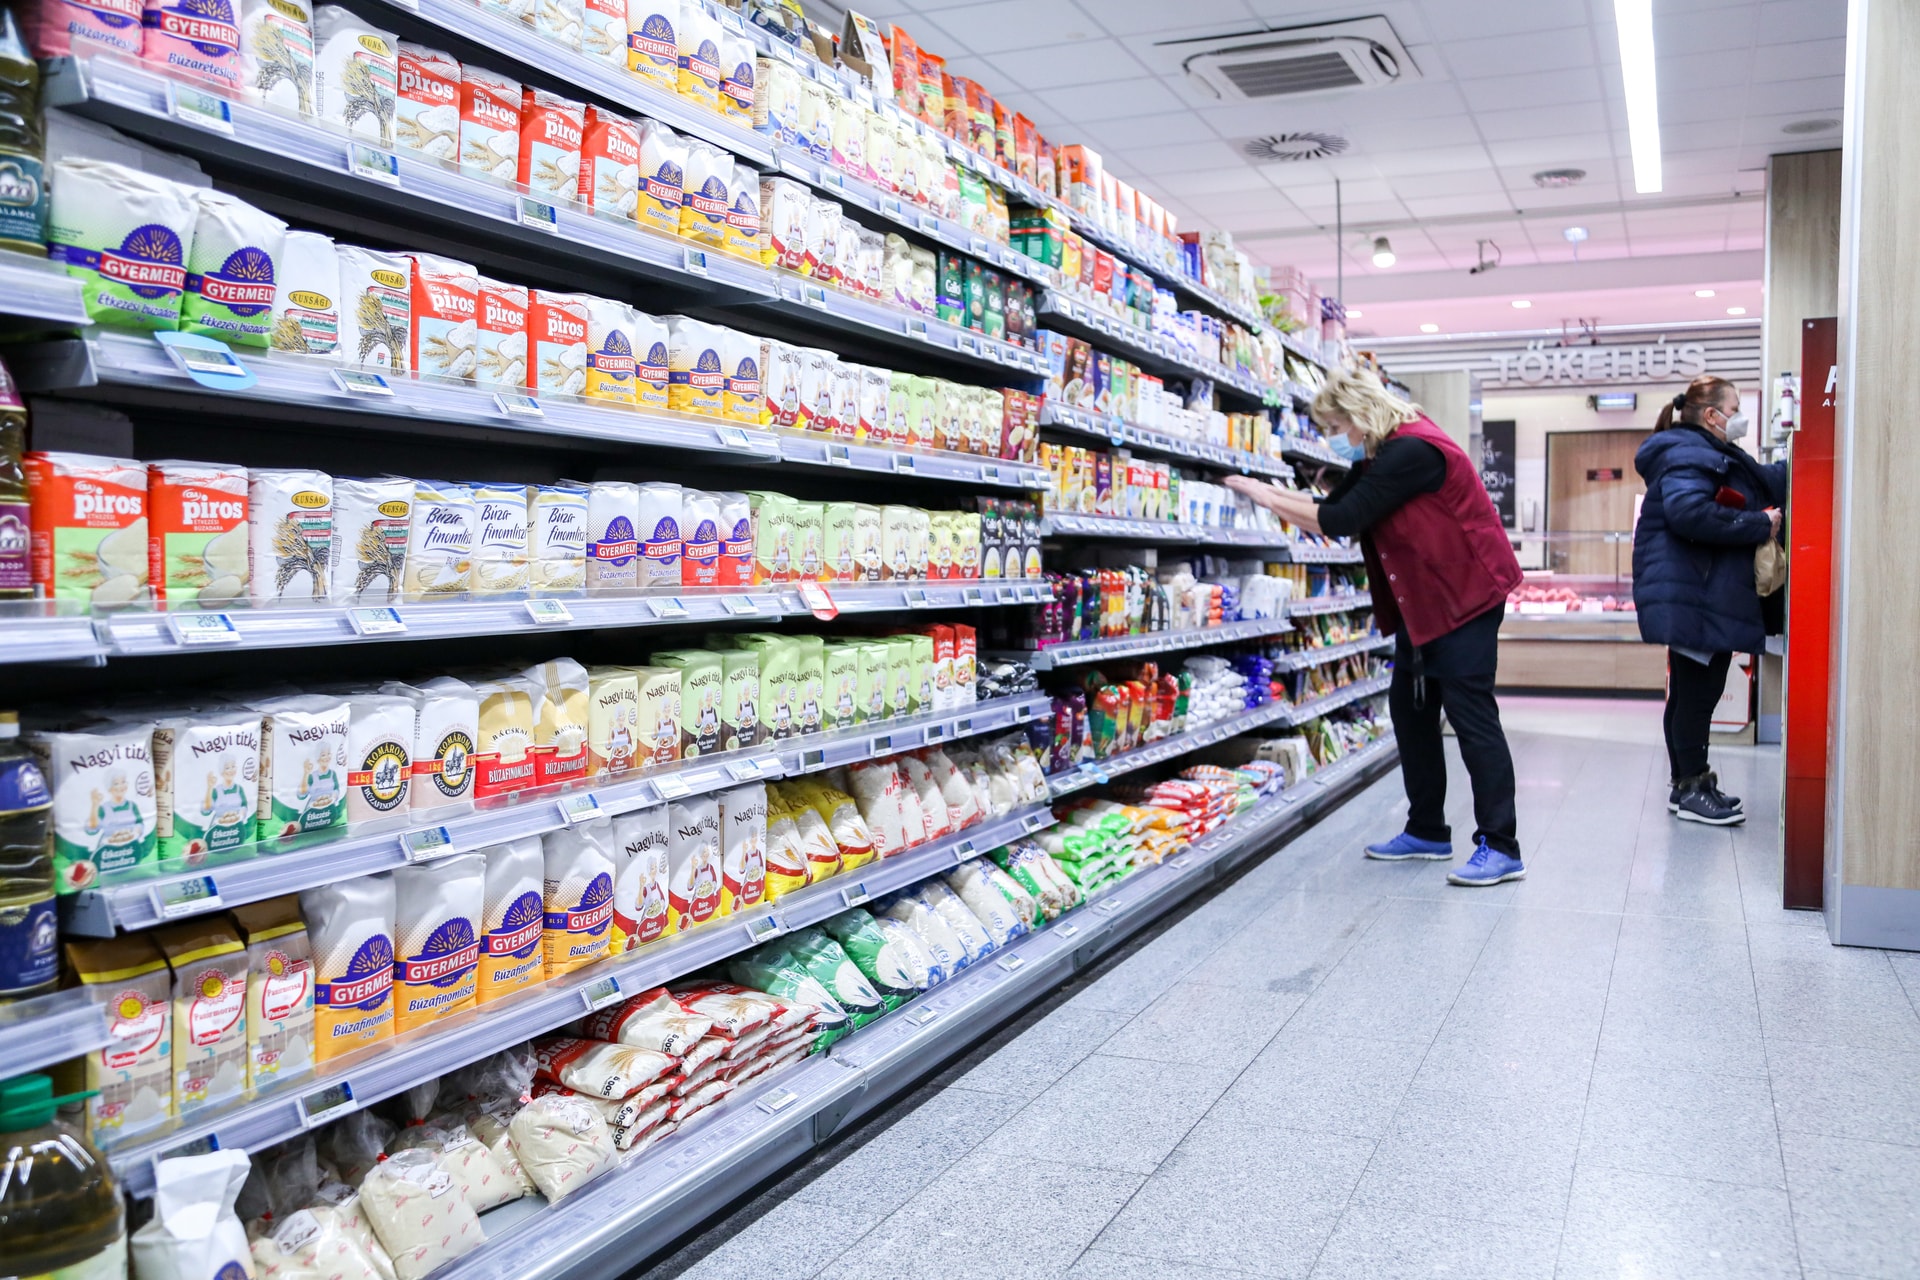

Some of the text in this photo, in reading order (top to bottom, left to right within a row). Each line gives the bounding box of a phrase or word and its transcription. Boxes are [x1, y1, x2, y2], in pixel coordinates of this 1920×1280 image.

[400, 70, 454, 100] piros
[473, 96, 517, 126] piros
[545, 119, 582, 146] piros
[607, 133, 638, 159] piros
[98, 291, 140, 314] Étkezési
[292, 293, 328, 308] KUNSÁGI
[431, 289, 475, 314] piros
[201, 315, 238, 331] Étkezési
[485, 302, 525, 326] piros
[547, 314, 584, 339] piros
[1490, 334, 1708, 386] TŐKEHÚS
[74, 487, 142, 520] piros
[182, 494, 243, 525] piros
[646, 682, 670, 701] Nagyi
[690, 672, 710, 690] Nagyi
[599, 689, 624, 709] Nagyi
[191, 730, 258, 759] Nagyi titka
[289, 722, 331, 747] Nagyi
[438, 731, 471, 755] KOMÁROMI
[492, 727, 528, 741] BÁCSKAI
[70, 743, 120, 774] Nagyi
[366, 742, 408, 767] KOMÁROMI
[734, 802, 757, 825] Nagyi
[624, 834, 655, 859] Nagyi
[181, 881, 201, 896] 359
[410, 947, 479, 980] GYERMELYI
[408, 982, 475, 1012] Búzafinomliszt
[664, 1038, 674, 1053] 500
[603, 1080, 615, 1096] 500
[616, 1109, 627, 1125] 500
